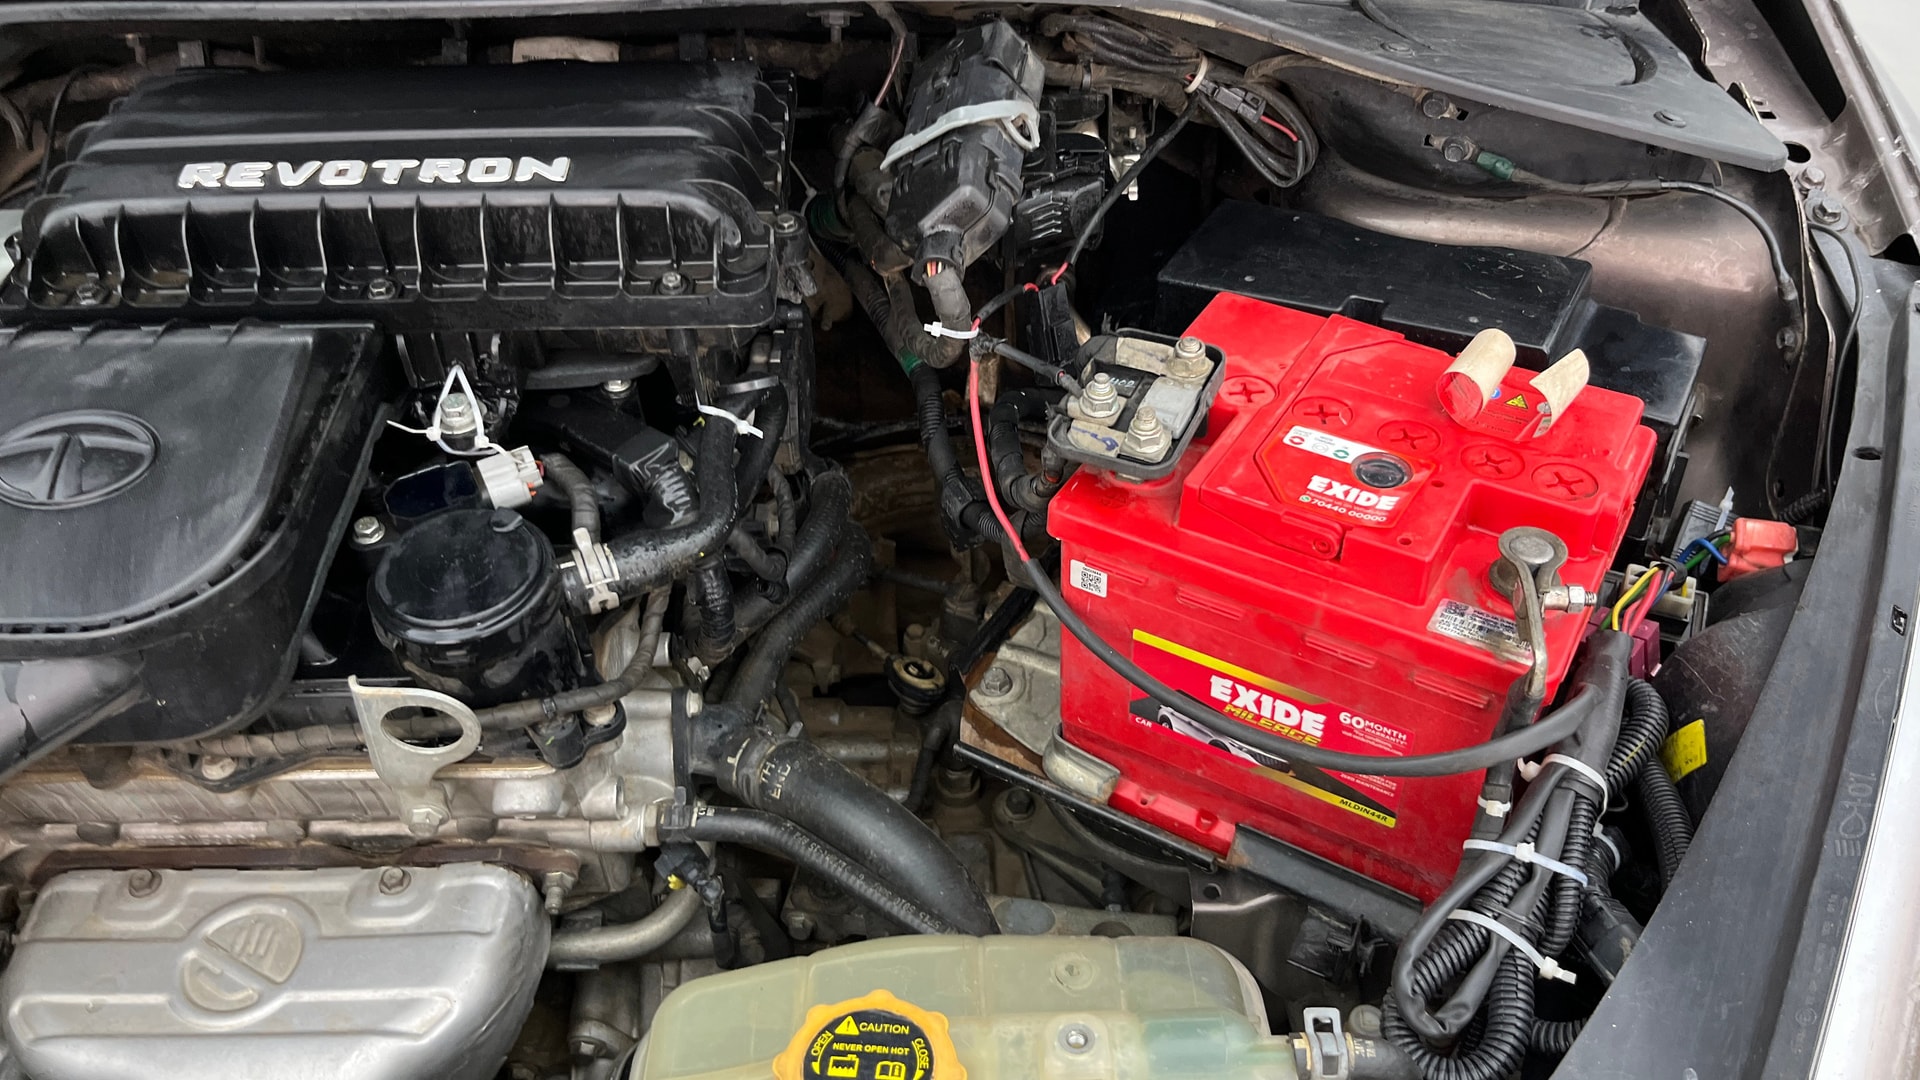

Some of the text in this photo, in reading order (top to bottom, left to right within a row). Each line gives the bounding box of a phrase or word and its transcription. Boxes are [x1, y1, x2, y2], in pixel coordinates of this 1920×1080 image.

[177, 155, 570, 189] REVOTRON
[1306, 475, 1400, 511] EXIDE
[1310, 498, 1387, 522] 70440 00000
[1210, 674, 1327, 738] EXIDE
[1135, 717, 1152, 728] CAR
[1222, 703, 1322, 747] MILEAGE
[1339, 711, 1407, 741] 60 MONTH
[1339, 798, 1389, 823] MLDIN44R
[859, 1021, 910, 1035] CAUTION
[811, 1030, 832, 1056] OPEN
[832, 1042, 910, 1056] NEVER OPEN HOT
[914, 1037, 930, 1070] CLOSE
